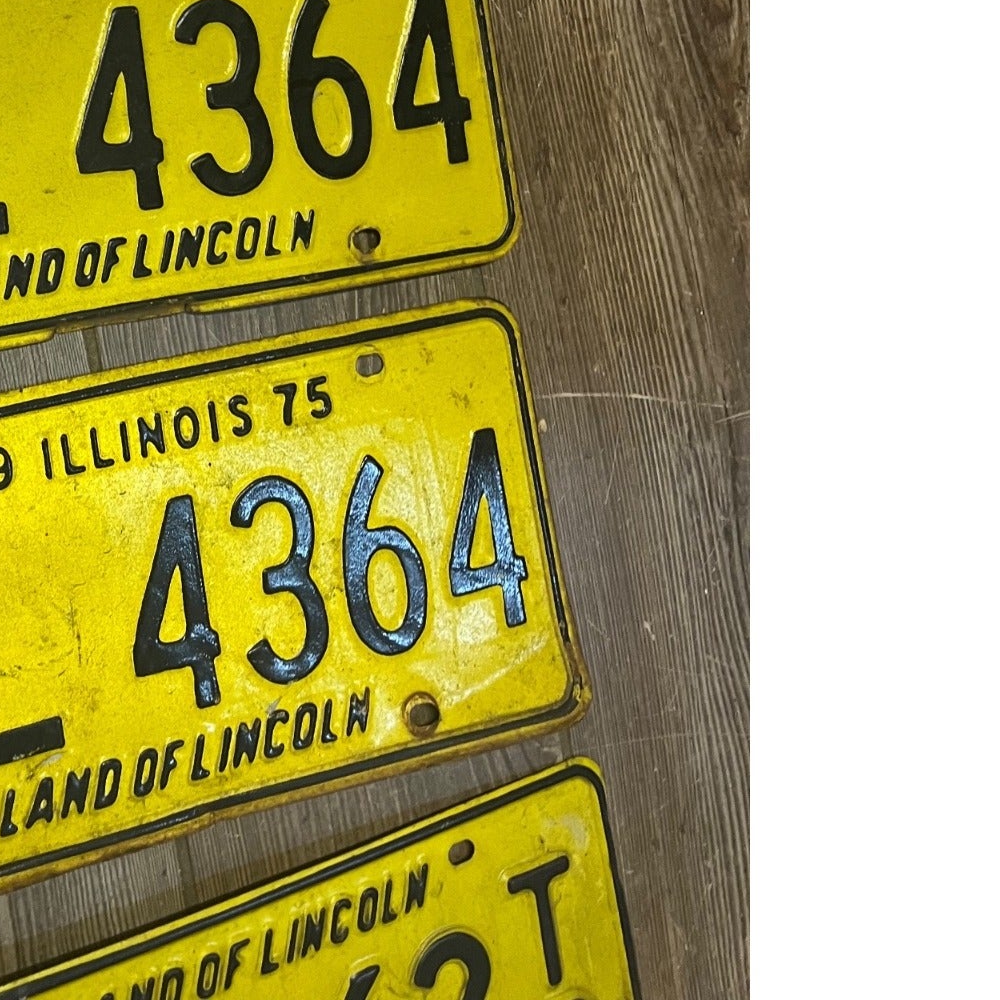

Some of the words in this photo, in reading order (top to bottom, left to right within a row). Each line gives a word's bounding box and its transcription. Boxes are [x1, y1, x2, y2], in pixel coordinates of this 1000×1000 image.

[74, 239, 127, 288] OF
[133, 209, 317, 279] LINCOLN
[42, 400, 252, 482] ILLINOIS
[273, 376, 332, 424] 75
[134, 428, 528, 710] 4364
[0, 757, 121, 837] LAND
[132, 741, 181, 796] OF
[194, 687, 372, 780] LINCOLN
[196, 938, 250, 1000] OF
[261, 862, 428, 975] LINCOLN
